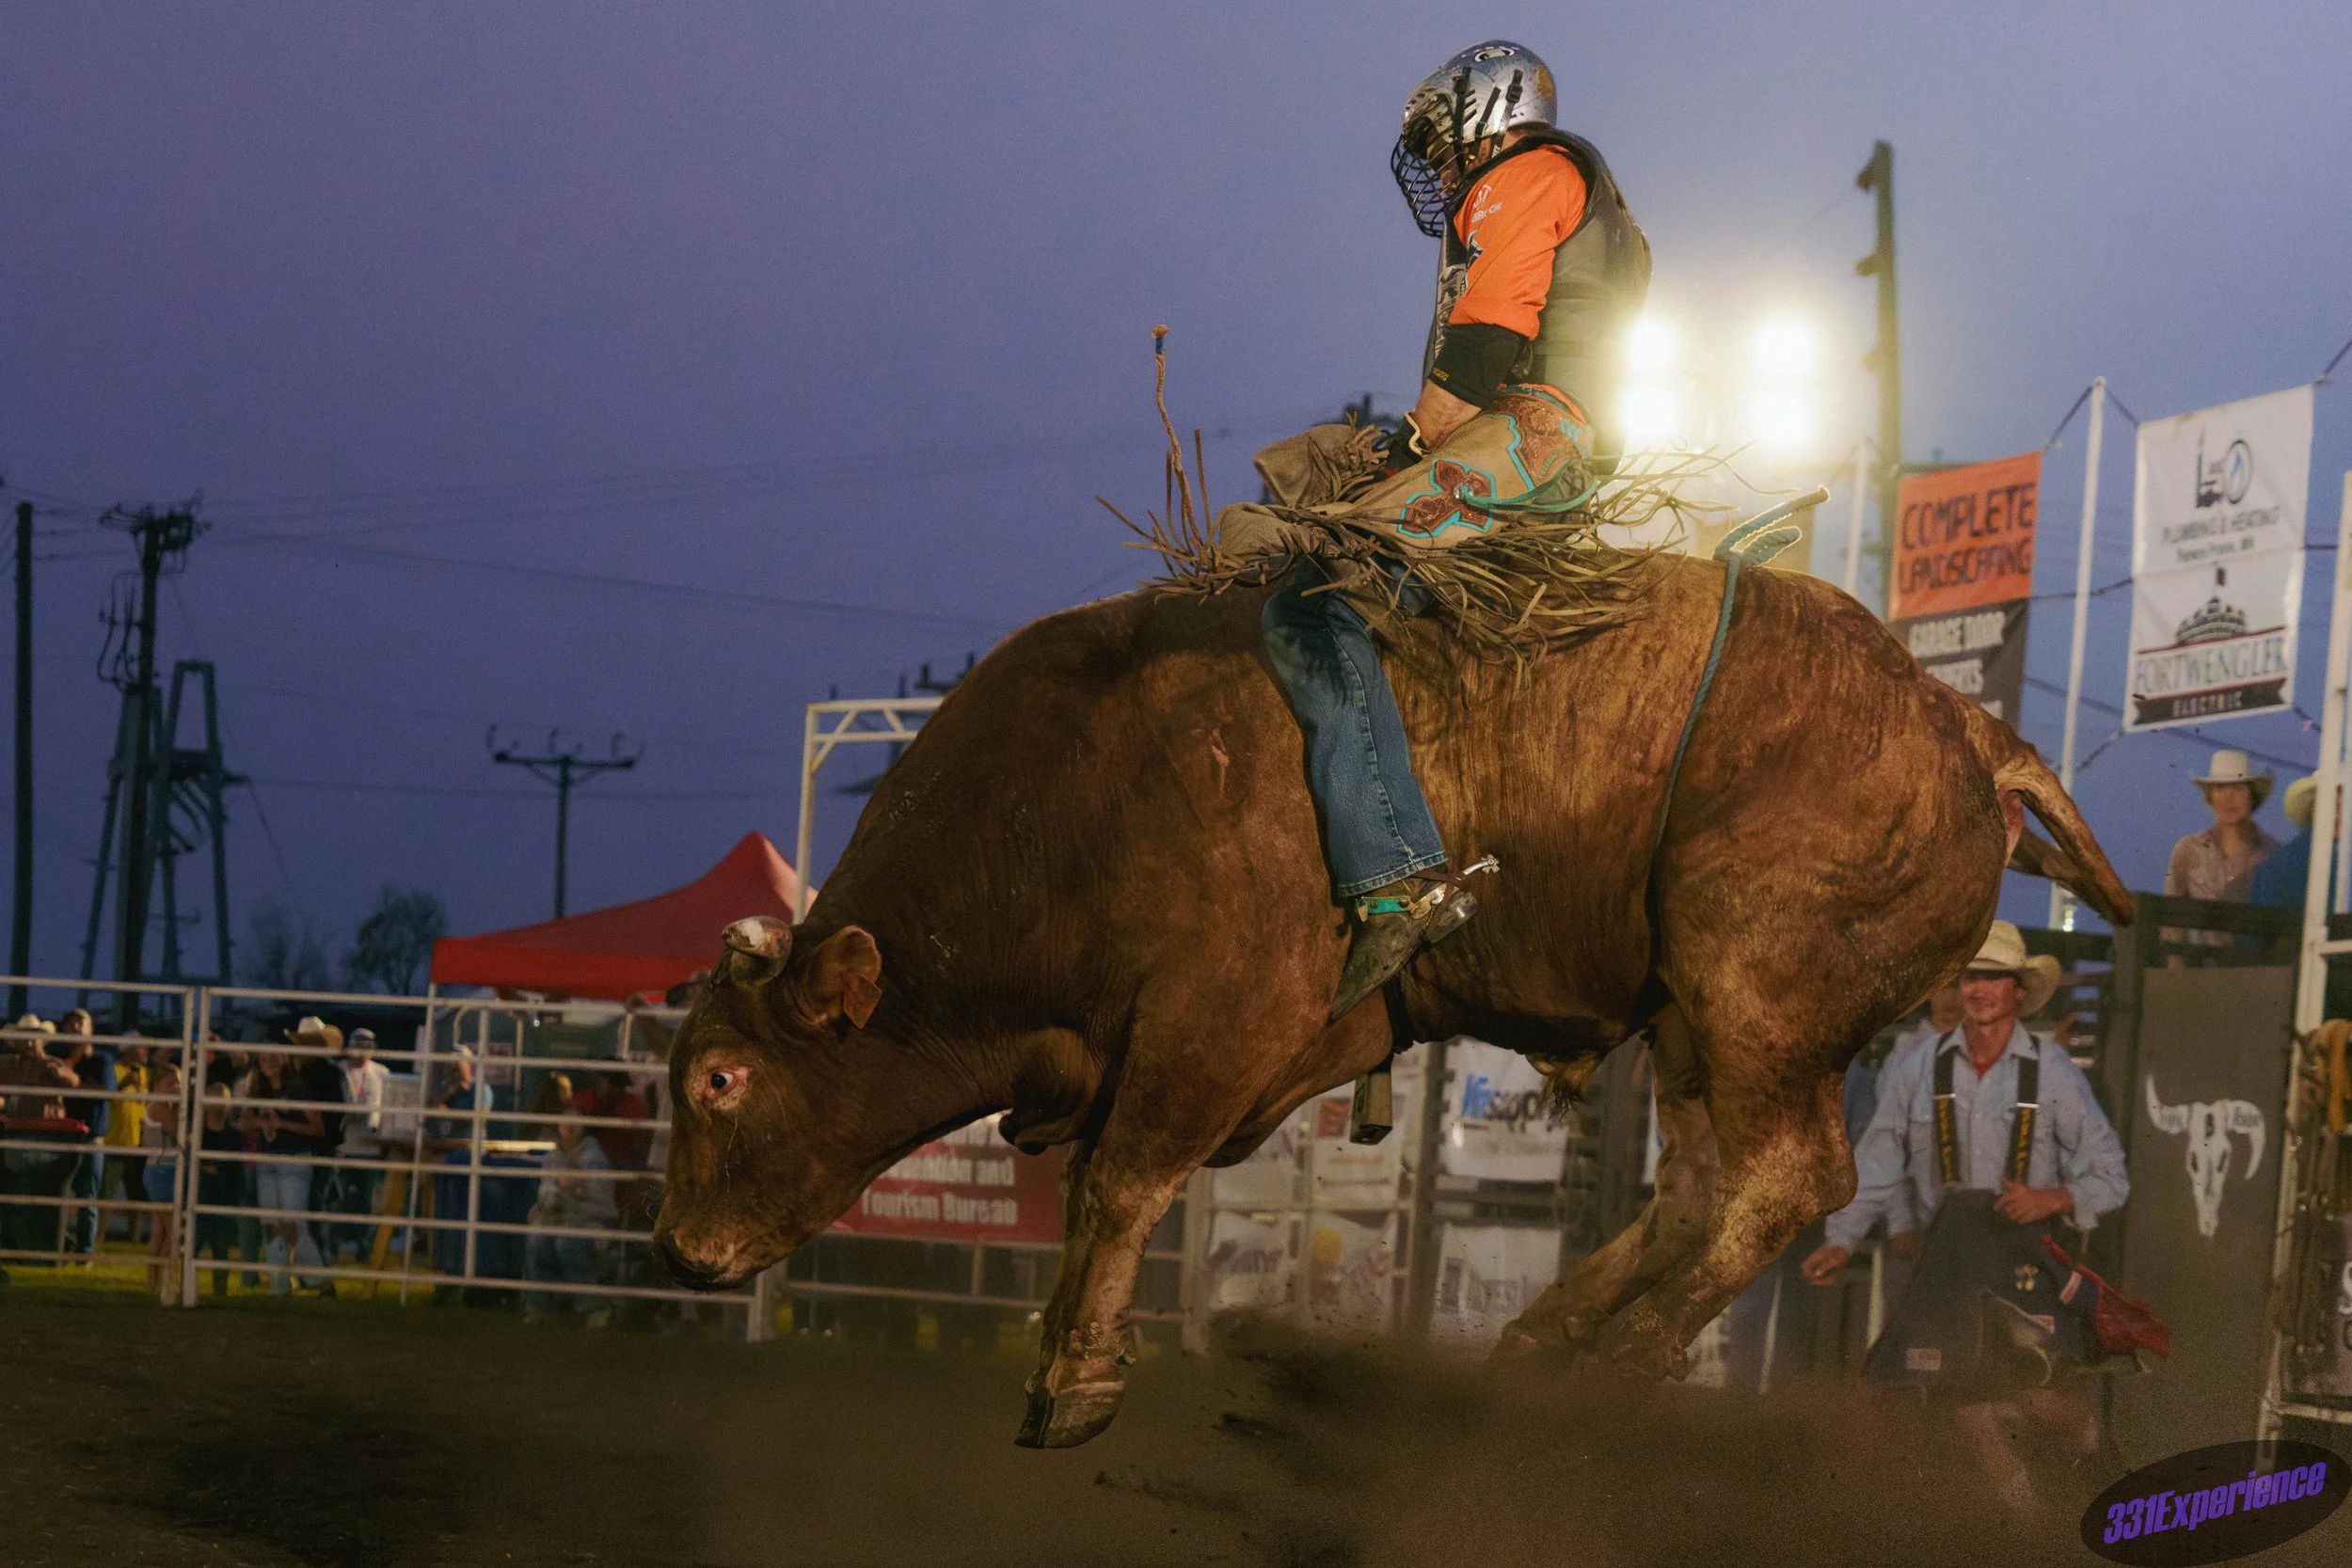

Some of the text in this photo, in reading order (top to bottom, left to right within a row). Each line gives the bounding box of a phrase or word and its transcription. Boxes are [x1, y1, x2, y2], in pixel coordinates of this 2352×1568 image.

[1901, 481, 2036, 551] COMPLETE
[1898, 536, 2033, 595] LANDSCAPING
[975, 1155, 1015, 1185] and
